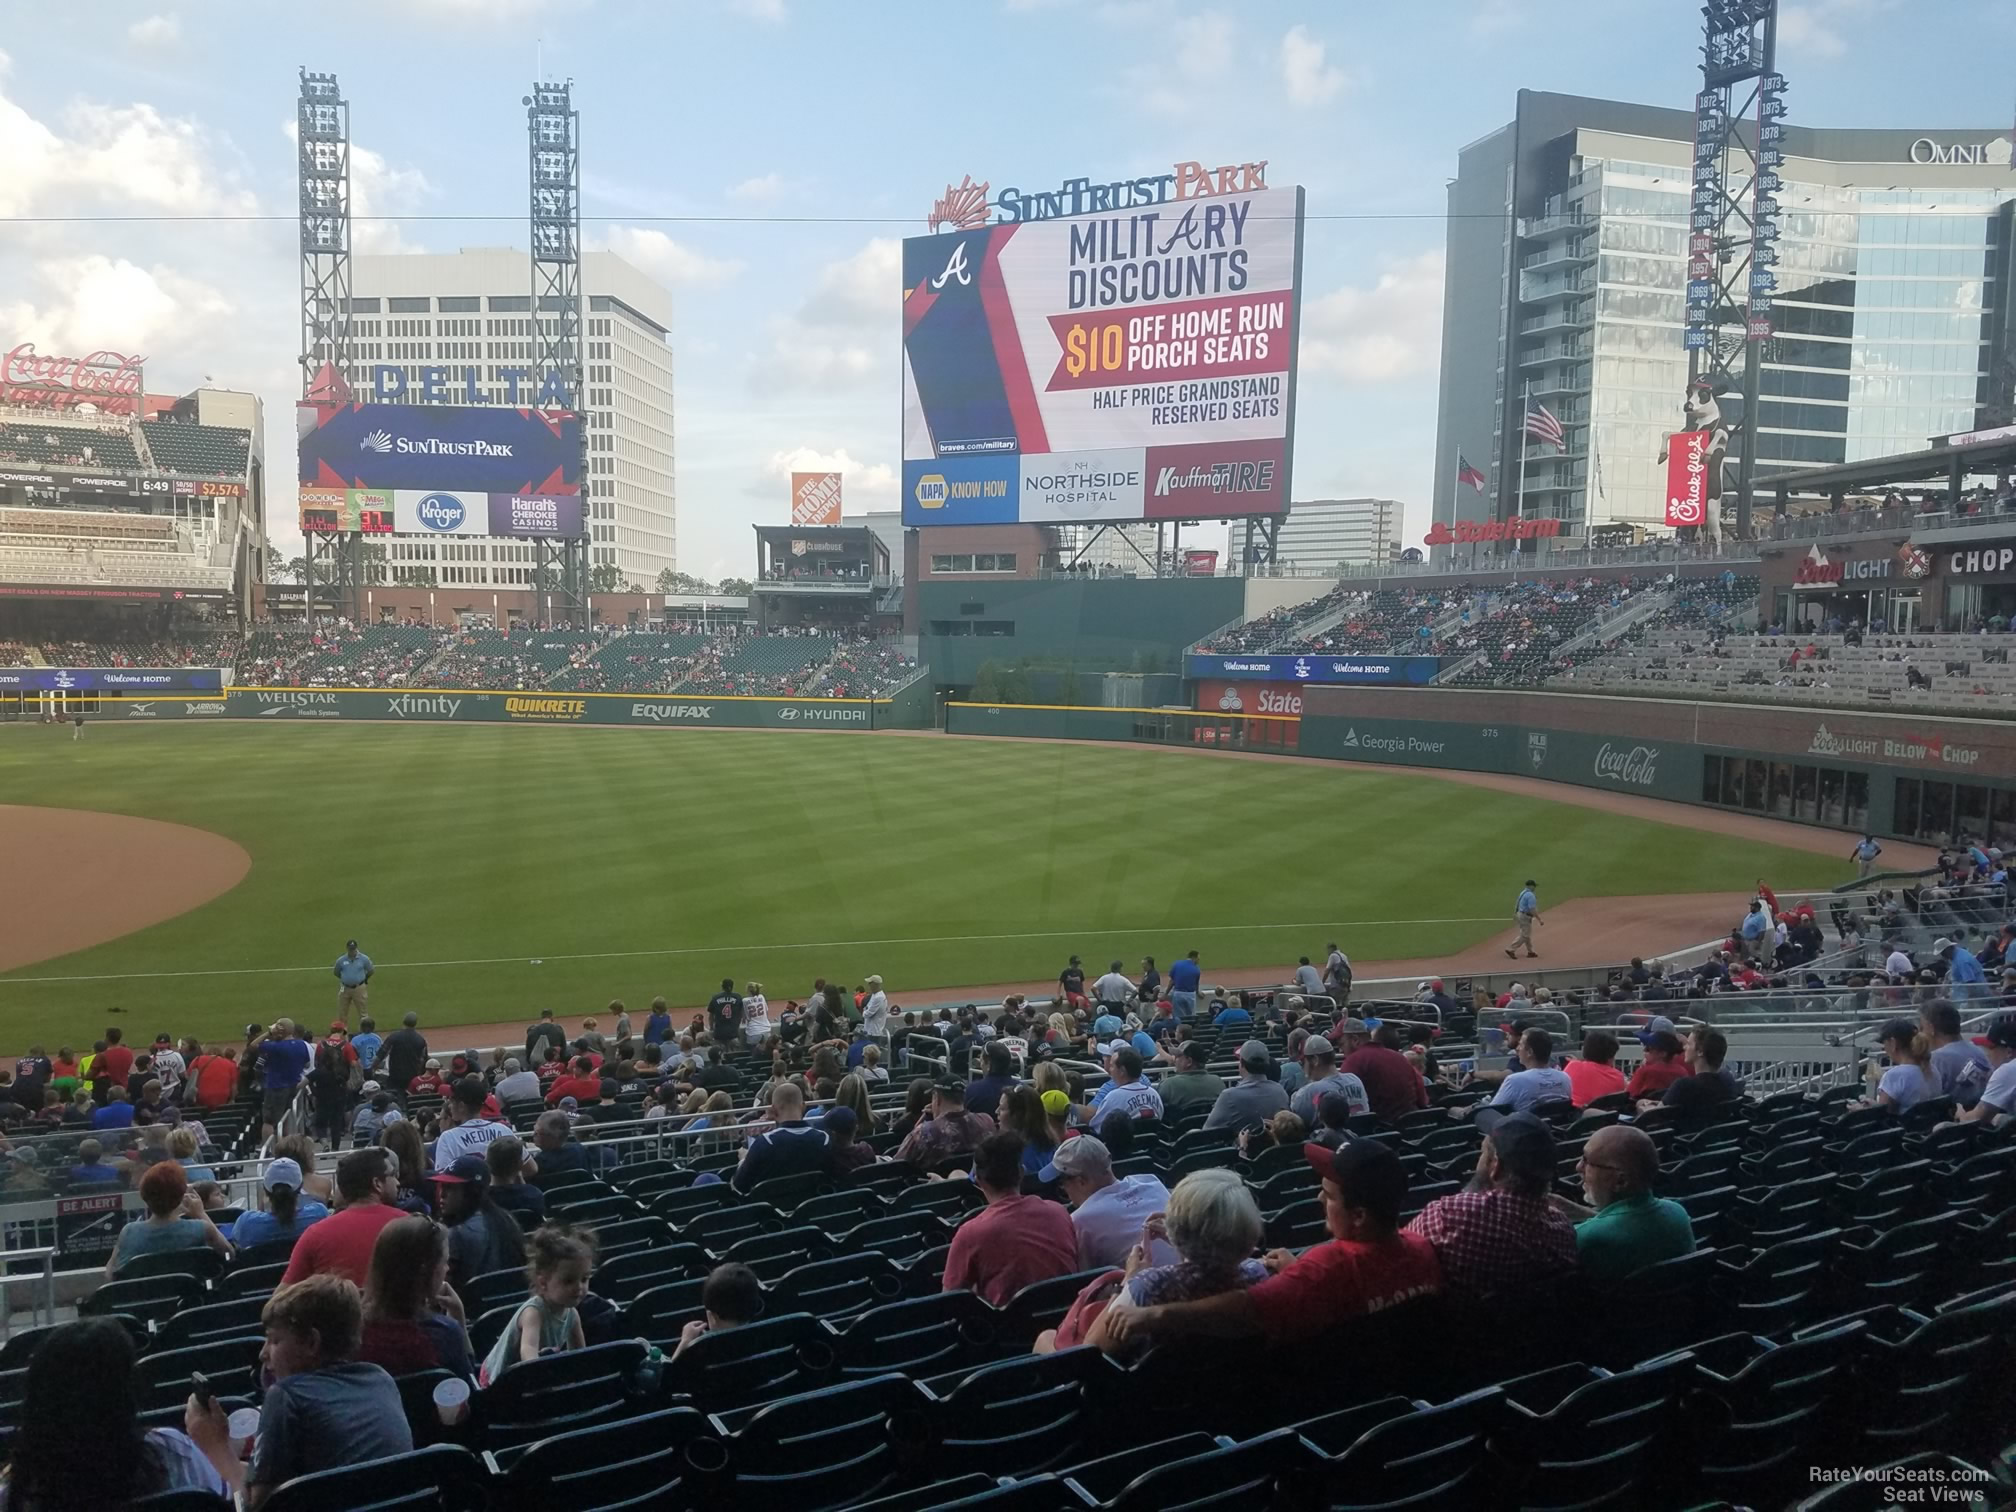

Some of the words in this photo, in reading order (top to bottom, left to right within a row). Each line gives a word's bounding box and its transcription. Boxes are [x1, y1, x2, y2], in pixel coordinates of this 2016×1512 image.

[1763, 77, 1780, 90] 1873
[1700, 95, 1716, 108] 1872
[1762, 102, 1779, 115] 1875
[1699, 119, 1716, 132] 1874
[1761, 127, 1779, 139] 1878
[1698, 143, 1714, 156] 1877
[1910, 138, 1985, 164] OMNI
[1760, 151, 1777, 164] 1891
[1697, 167, 1713, 179] 1883
[1758, 176, 1776, 189] 1893
[1696, 191, 1713, 203] 1892
[1757, 200, 1776, 213] 1898
[1694, 215, 1711, 227] 1897
[1070, 201, 1251, 266] MILITARY
[1756, 225, 1774, 238] 1948
[1693, 239, 1709, 251] 1914
[1754, 250, 1773, 262] 1958
[1691, 262, 1709, 274] 1957
[1069, 249, 1248, 309] DISCOUNTS
[1753, 274, 1771, 286] 1982
[1690, 286, 1708, 297] 1969
[1751, 299, 1770, 310] 1992
[1689, 309, 1706, 321] 1991
[1129, 315, 1166, 344] OFF
[1171, 308, 1232, 339] HOME
[1239, 302, 1284, 332] RUN
[1750, 323, 1769, 335] 1995
[1688, 333, 1705, 345] 1993
[1066, 324, 1123, 378] $10
[1128, 340, 1197, 371] PORCH
[1204, 333, 1268, 364] SEATS
[375, 364, 572, 405] DELTA
[1093, 389, 1128, 409] HALF
[1131, 386, 1174, 407] PRICE
[1179, 376, 1280, 403] GRANDSTAND
[1152, 402, 1227, 425] RESERVED
[1233, 398, 1279, 420] SEATS
[940, 440, 1014, 452] braves.com/military
[72, 477, 127, 487] POWERADE
[1026, 471, 1139, 491] NORTHSIDE
[1154, 466, 1230, 496] Kauffman
[1211, 460, 1275, 494] TIRE
[143, 480, 168, 491] 6:49
[202, 482, 239, 496] $2,574
[797, 478, 818, 498] THE
[920, 483, 944, 500] NAPA
[951, 481, 981, 498] KNOW
[984, 480, 1007, 498] HOW
[512, 497, 556, 511] Harrah's
[793, 473, 841, 523] HOME
[1045, 491, 1117, 504] HOSPITAL
[421, 499, 462, 527] Kroger
[811, 491, 841, 524] DEPOT
[361, 512, 382, 525] 37
[512, 510, 557, 519] CHEROKEE
[512, 519, 557, 527] CASINOS
[1453, 518, 1504, 544] State
[1504, 515, 1560, 539] Farm
[1951, 548, 2014, 573] CHOP
[1844, 558, 1891, 580] LIGHT
[1224, 661, 1248, 671] Welcome
[1333, 662, 1363, 673] Welcome
[104, 674, 141, 683] Welcome
[257, 692, 337, 706] WELLSTAR
[388, 693, 461, 717] xfinity
[505, 697, 585, 713] QUIKRETE
[1258, 689, 1301, 714] State
[318, 709, 340, 717] System
[631, 703, 712, 720] EQUIFAX
[804, 709, 866, 721] HYUNDAI
[1482, 729, 1498, 738] 375
[1530, 734, 1546, 745] MLB
[1361, 734, 1406, 752] Georgia
[1408, 737, 1444, 753] Power
[1846, 740, 1878, 755] LIGHT
[1884, 739, 1927, 759] BELOW
[1942, 745, 1979, 764] CHOP
[722, 1004, 732, 1018] 4
[747, 1004, 764, 1017] 22
[21, 1063, 33, 1075] 5
[160, 1070, 171, 1086] 7
[621, 1083, 638, 1092] JONES
[1127, 1092, 1163, 1110] FREEMAN
[460, 1130, 502, 1147] MEDINA
[64, 1202, 78, 1211] BE
[81, 1198, 118, 1209] ALERT
